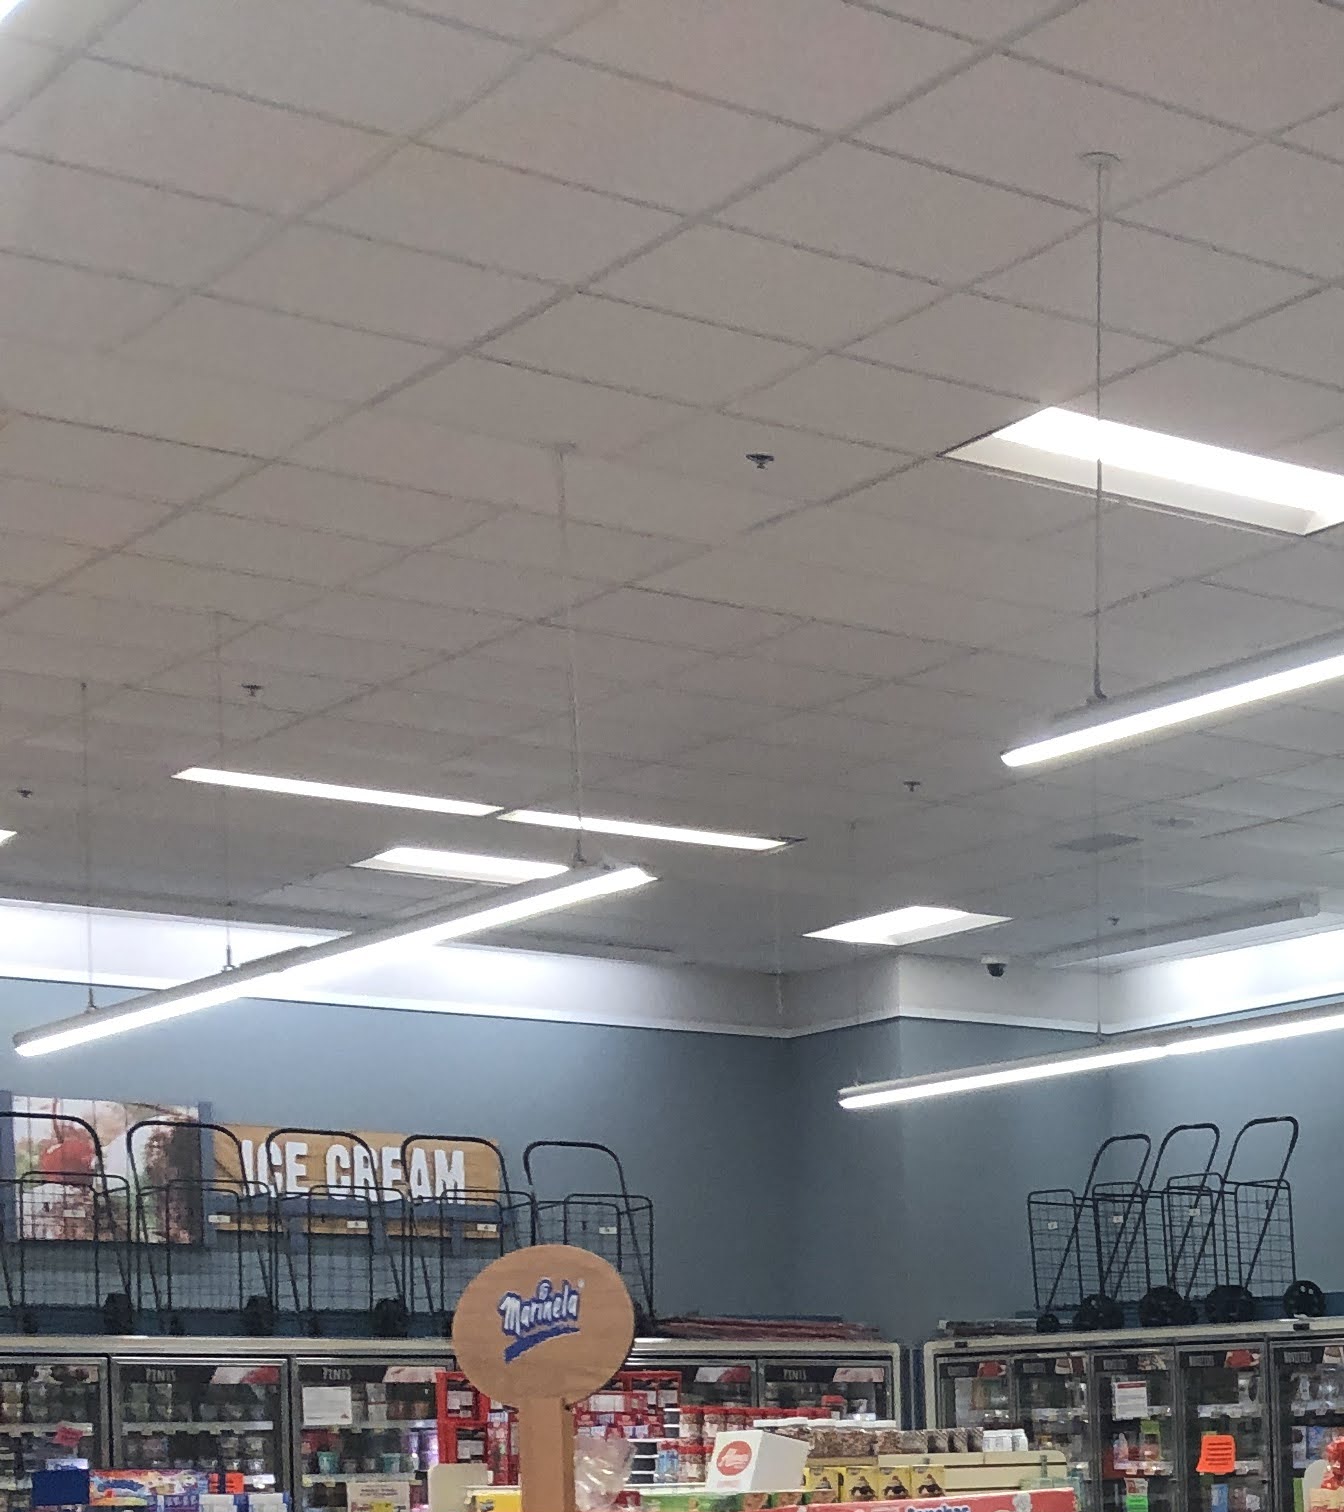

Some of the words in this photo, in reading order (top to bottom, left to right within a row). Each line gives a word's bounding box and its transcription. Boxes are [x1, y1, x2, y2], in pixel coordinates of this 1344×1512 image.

[242, 1140, 309, 1199] ICE
[326, 1143, 466, 1205] CREAM
[498, 1279, 579, 1336] Marinela
